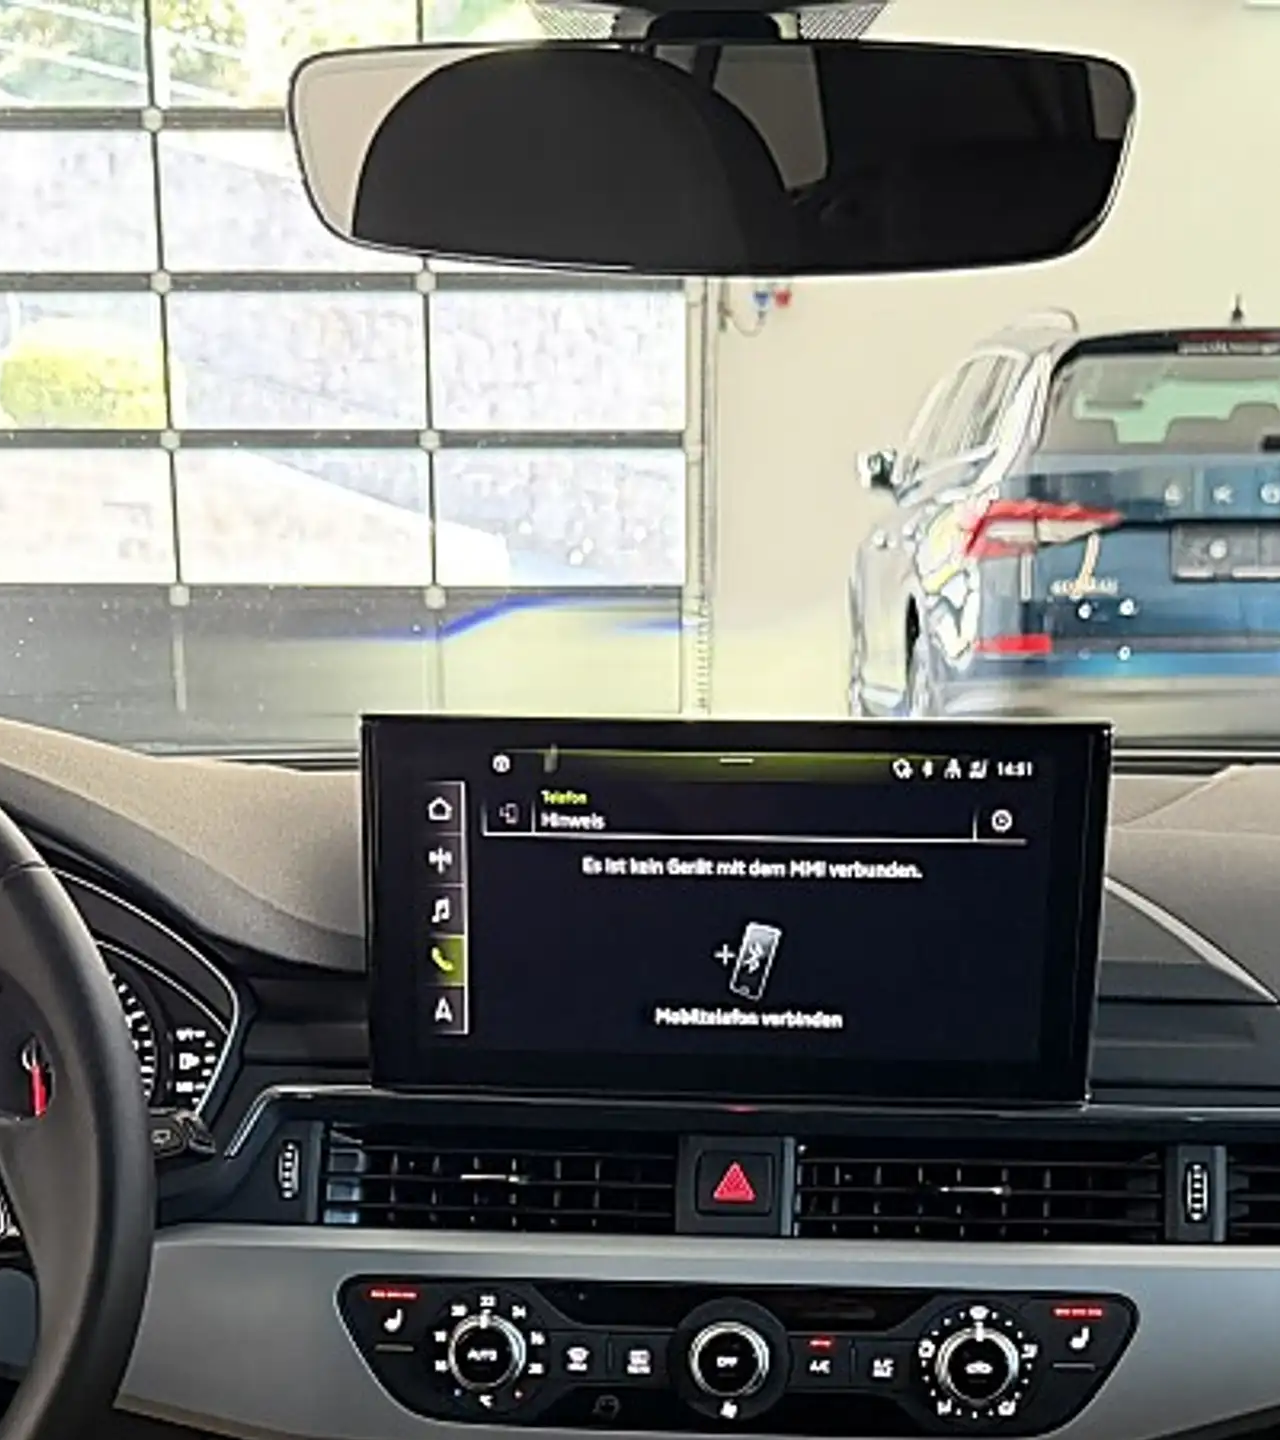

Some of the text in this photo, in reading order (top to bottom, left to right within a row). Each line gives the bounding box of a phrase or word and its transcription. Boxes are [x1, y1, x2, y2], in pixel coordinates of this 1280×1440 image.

[541, 790, 588, 804] Telefon
[541, 812, 606, 830] Hinweis
[582, 857, 602, 875] Es
[605, 857, 627, 875] ist
[630, 857, 664, 875] kein
[666, 857, 713, 876] Gerät
[717, 858, 746, 876] mit
[749, 859, 785, 877] dem
[828, 860, 923, 879] verbunden.
[655, 1007, 843, 1029] Mobiltelefon verbinden
